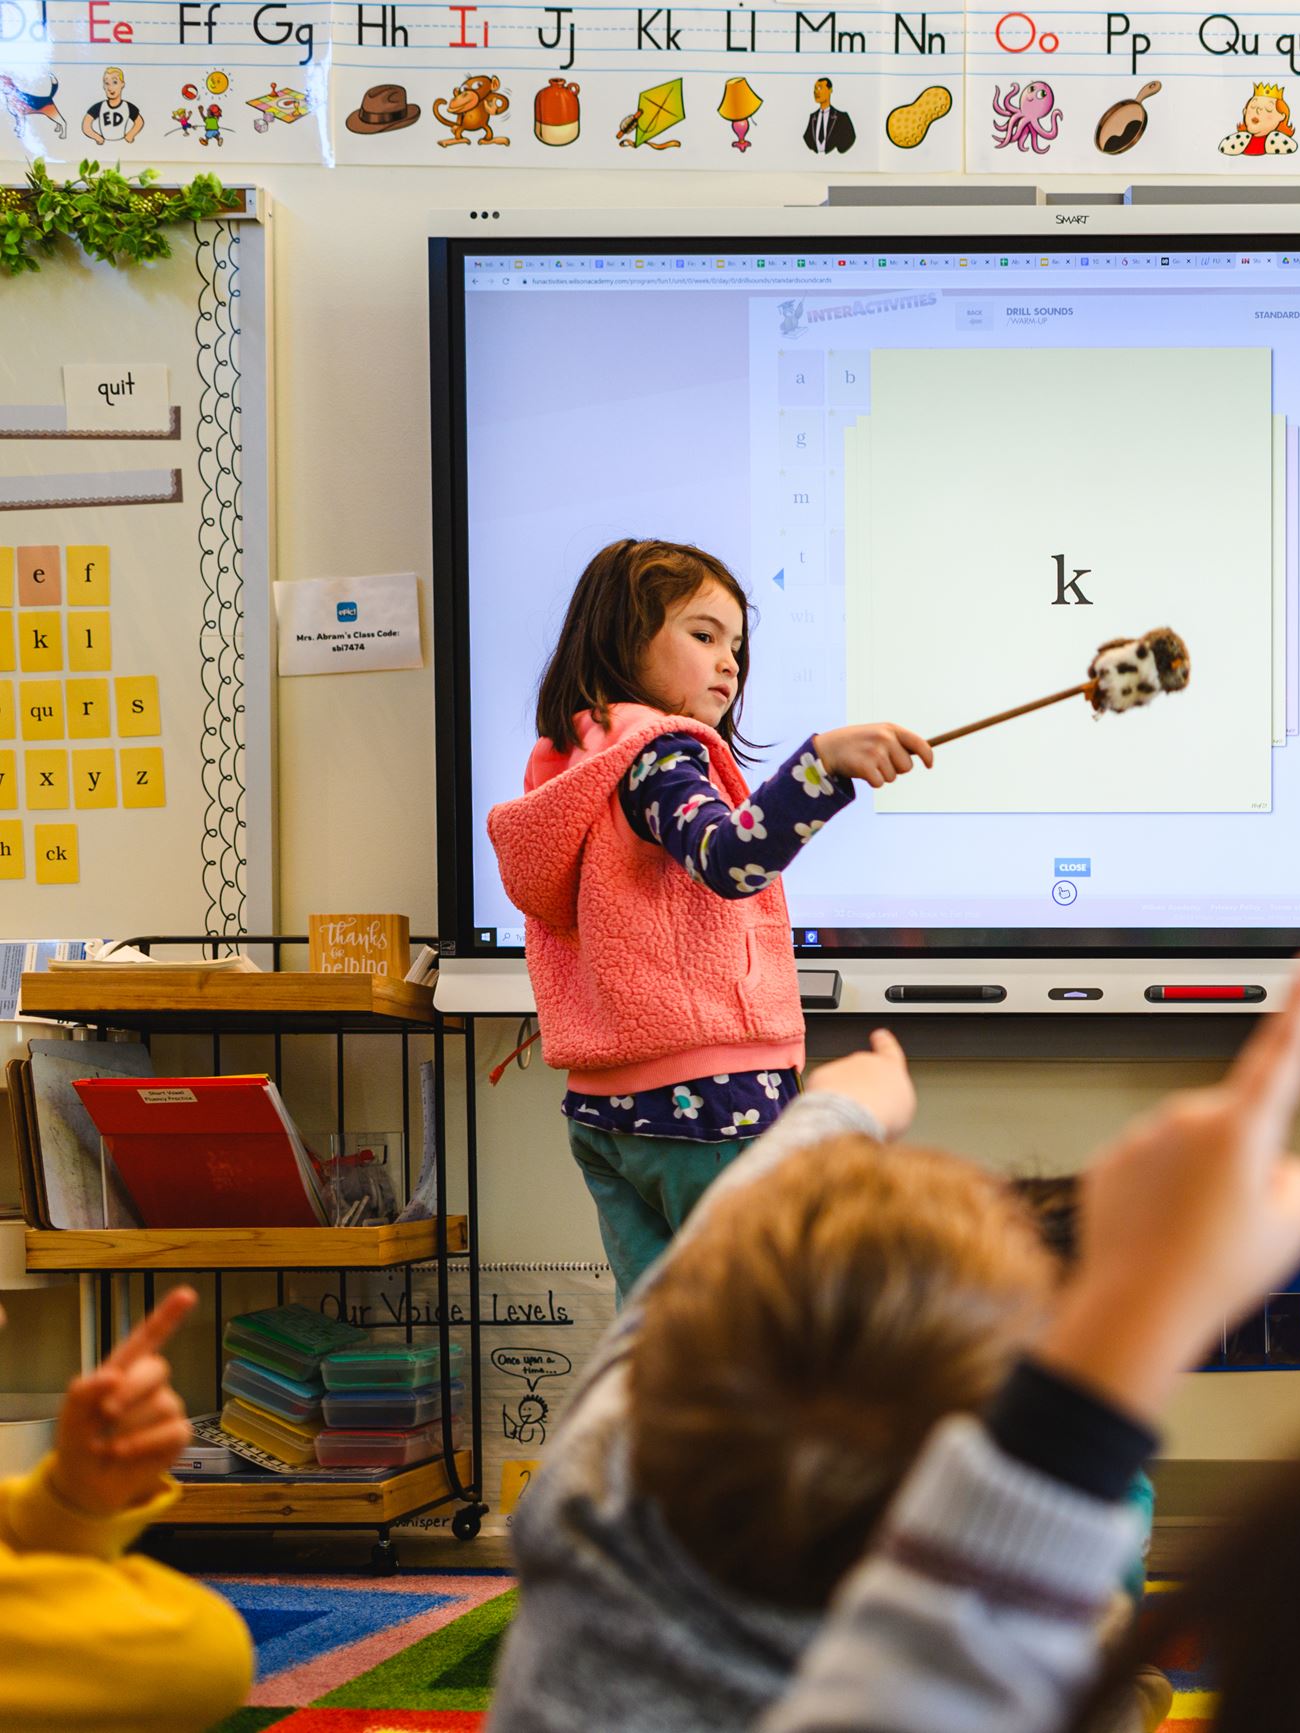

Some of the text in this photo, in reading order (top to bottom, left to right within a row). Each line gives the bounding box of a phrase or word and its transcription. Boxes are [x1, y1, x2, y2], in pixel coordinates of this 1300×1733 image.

[88, 1, 134, 43] Ee
[179, 3, 221, 44] Ff
[253, 3, 313, 66] Gg
[357, 4, 409, 48] Hh
[448, 6, 489, 48] Ii
[538, 8, 575, 70] Jj
[637, 9, 682, 51] Kk
[726, 10, 755, 52] Ll
[795, 11, 866, 53] Mm
[894, 13, 946, 54] Nn
[995, 12, 1059, 53] Oo
[1107, 13, 1151, 75] Pp
[1199, 15, 1259, 57] Qu
[102, 112, 124, 127] ED
[1055, 214, 1090, 225] SMART
[1006, 307, 1074, 316] DRILL SOUNDS
[1254, 310, 1300, 319] STANDARD
[795, 371, 806, 384] a
[845, 369, 856, 384] b
[98, 372, 135, 406] quit
[796, 432, 807, 447] g
[793, 492, 810, 504] m
[33, 568, 45, 583] e
[85, 562, 95, 582] f
[1051, 554, 1093, 604] k
[33, 629, 48, 649] k
[85, 629, 93, 648] l
[317, 632, 351, 641] Abram's
[353, 631, 375, 639] Class
[377, 630, 400, 638] Code:
[332, 643, 365, 652] sbi7474
[30, 704, 54, 722] qu
[82, 700, 94, 716] r
[132, 699, 144, 714] s
[40, 771, 55, 787] x
[88, 772, 101, 792] y
[137, 770, 149, 785] z
[46, 845, 67, 862] ck
[1059, 863, 1087, 872] CLOSE
[320, 917, 388, 954] thanks
[492, 1289, 569, 1322] Levels
[498, 1354, 521, 1366] Once
[523, 1356, 543, 1367] upon
